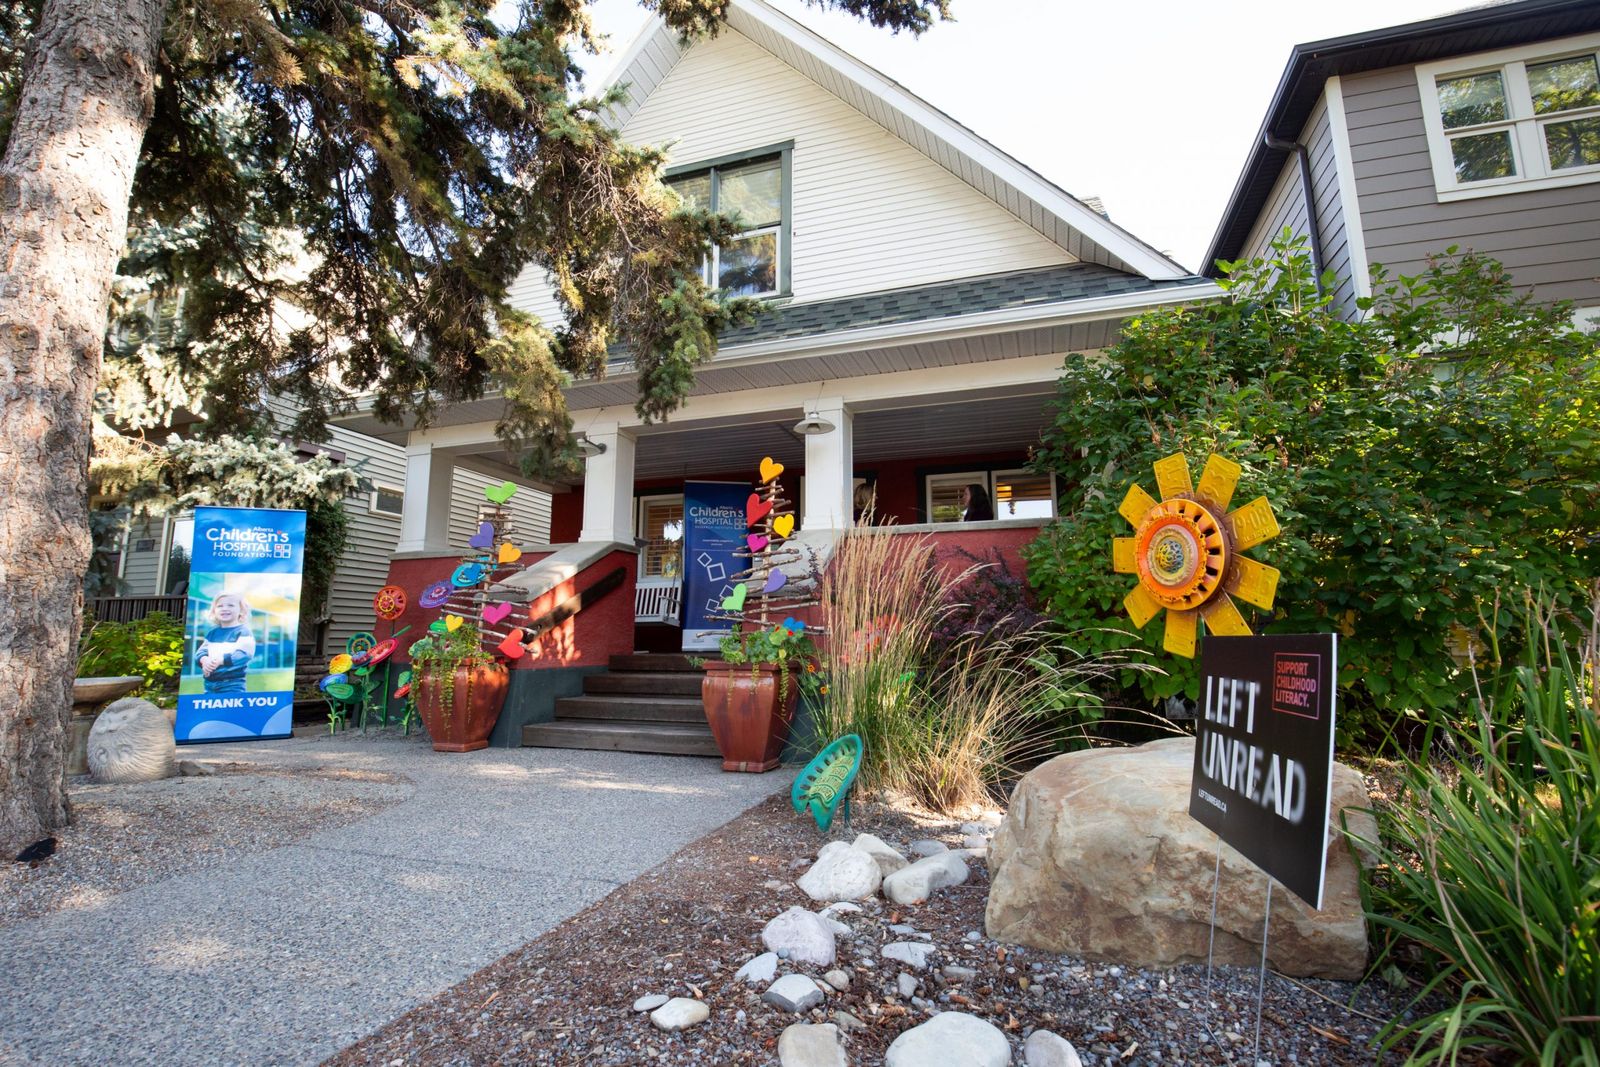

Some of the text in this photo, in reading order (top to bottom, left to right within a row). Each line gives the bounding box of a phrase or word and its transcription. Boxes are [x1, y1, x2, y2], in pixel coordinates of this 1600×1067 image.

[690, 506, 744, 518] Children's
[695, 517, 733, 525] HOSPITAL
[206, 527, 290, 543] Children's
[213, 542, 272, 552] HOSPITAL
[1276, 661, 1309, 676] SUPPORT
[1276, 675, 1317, 693] CHILDHOOD
[192, 696, 278, 710] THANK YOU
[1204, 675, 1260, 734] LEFT
[1275, 689, 1310, 708] LITERACY.
[1201, 728, 1308, 824] UNREAD
